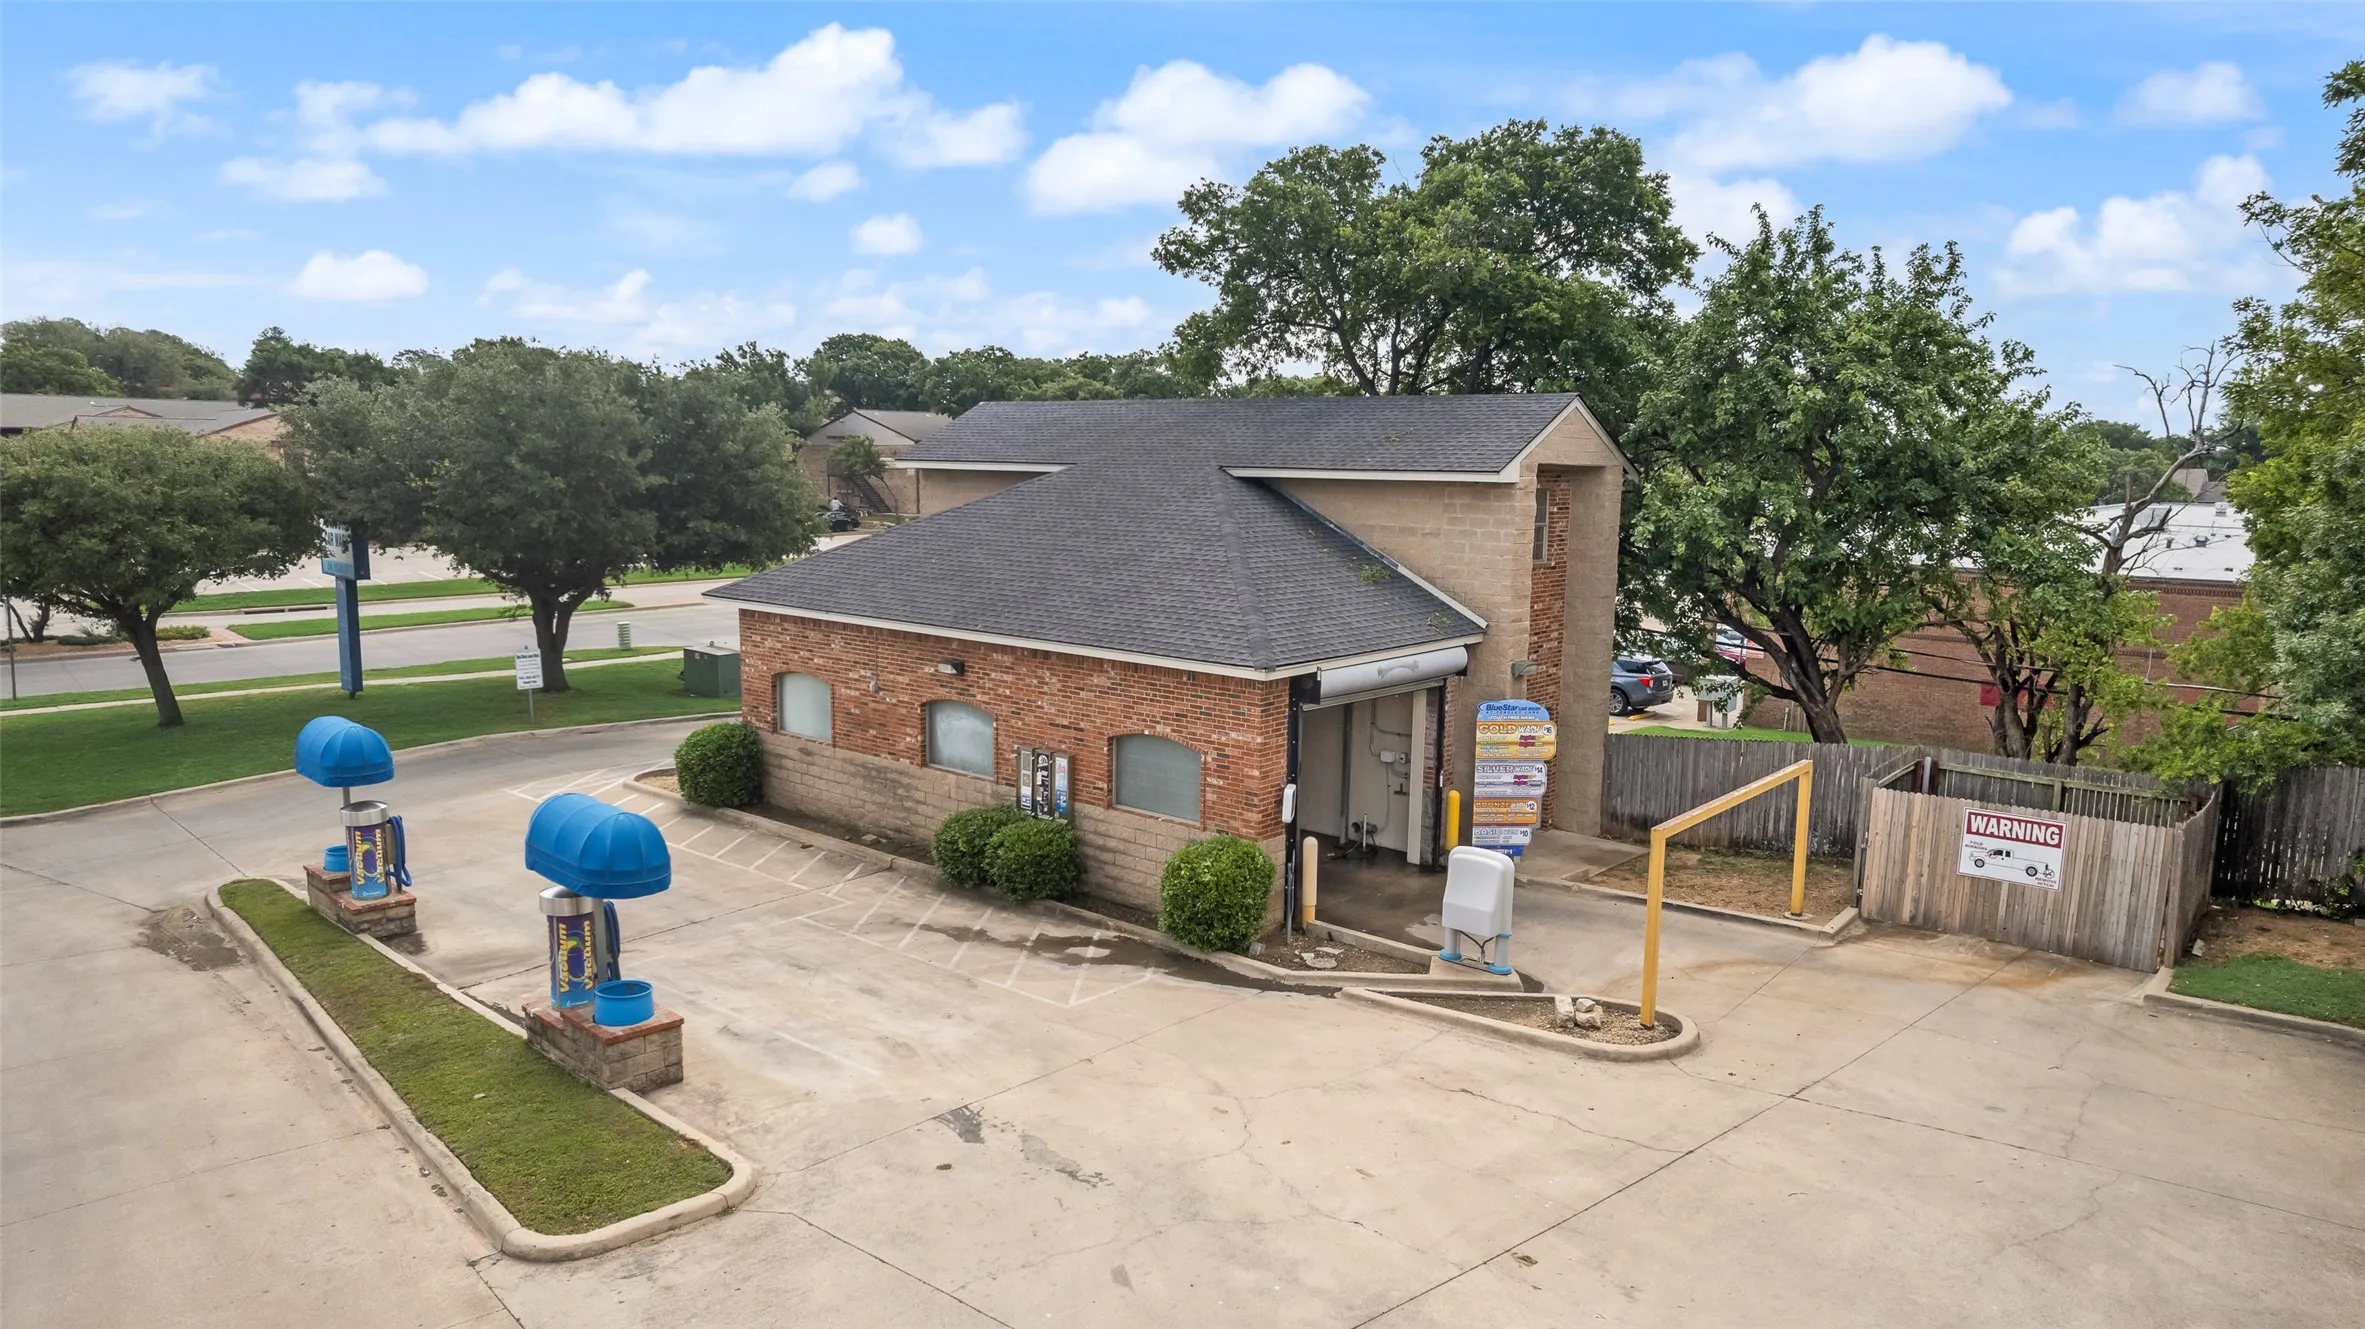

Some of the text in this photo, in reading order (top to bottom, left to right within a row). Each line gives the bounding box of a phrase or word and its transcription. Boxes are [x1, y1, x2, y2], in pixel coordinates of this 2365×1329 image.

[1479, 723, 1517, 735] GOLD
[1518, 725, 1540, 733] WASH
[1477, 764, 1543, 774] SILVER WASH $14
[1526, 803, 1535, 811] $12
[1519, 830, 1529, 838] $10
[1970, 814, 2060, 845] WARNING
